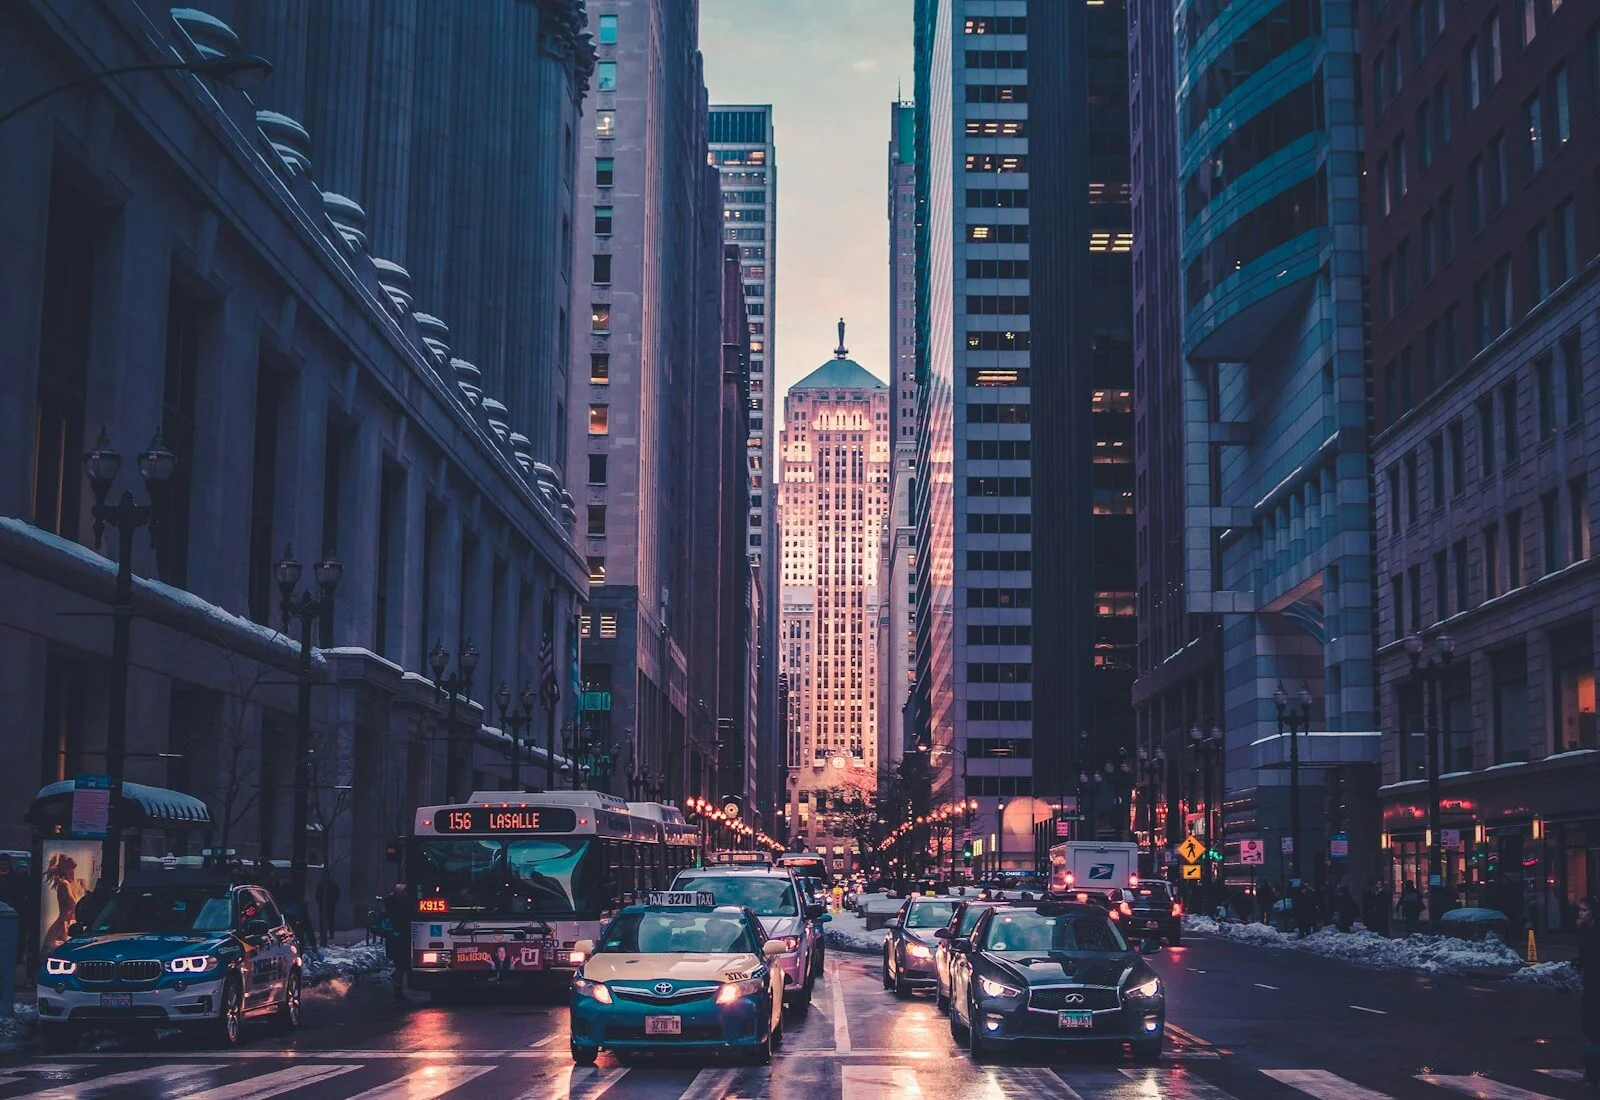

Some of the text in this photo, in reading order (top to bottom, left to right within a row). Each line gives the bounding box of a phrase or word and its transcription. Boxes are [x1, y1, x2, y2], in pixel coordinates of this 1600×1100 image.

[449, 812, 540, 830] 156 LASALLE
[649, 893, 713, 905] TAXI 3270 TAXI
[419, 901, 446, 911] K915
[651, 1020, 668, 1030] 3270
